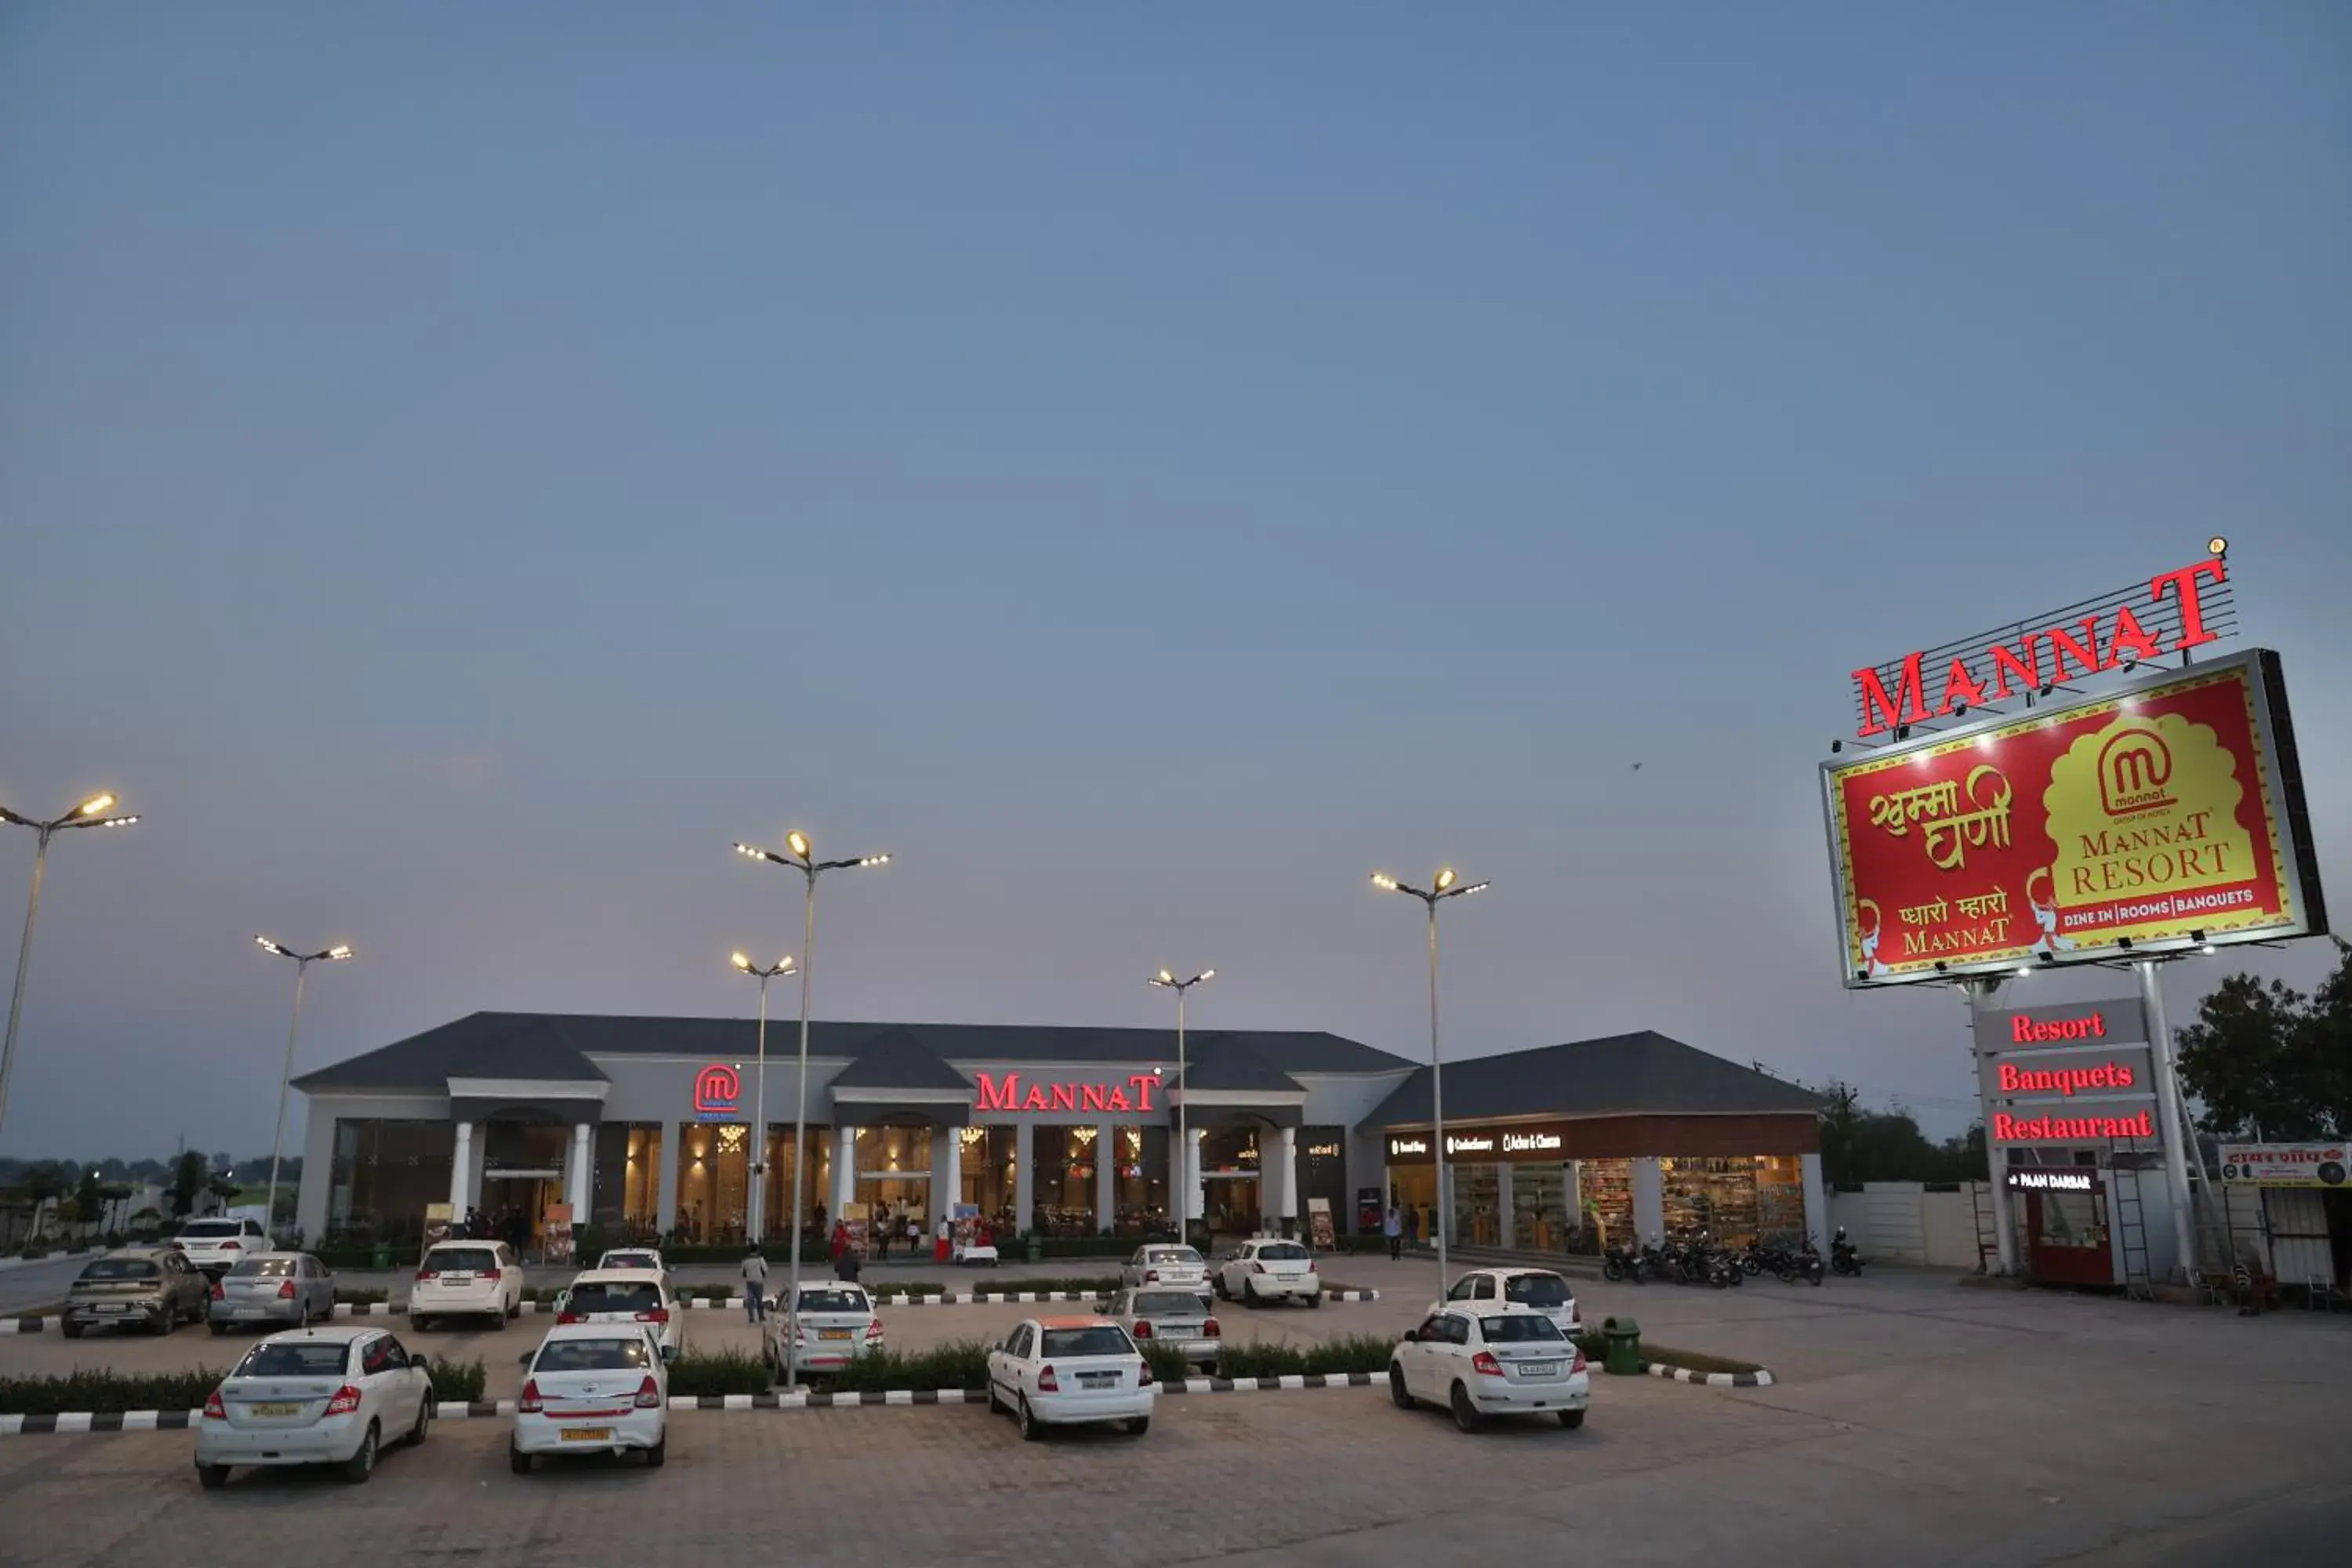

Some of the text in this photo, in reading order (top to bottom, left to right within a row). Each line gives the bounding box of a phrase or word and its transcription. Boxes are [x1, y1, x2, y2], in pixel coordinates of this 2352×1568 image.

[1851, 557, 2227, 738] MANNAT
[2079, 811, 2211, 860] MANNAT
[2073, 841, 2230, 895] RESORT
[2064, 889, 2254, 927] DINE IN ROOMS BANQUETS
[1903, 916, 2009, 956] MANNAT
[2012, 1012, 2107, 1043] Resort
[975, 1072, 1161, 1112] MANNAT
[1998, 1061, 2133, 1095] Banquets
[1994, 1109, 2154, 1141] Restaurant
[2020, 1173, 2048, 1188] PAAN
